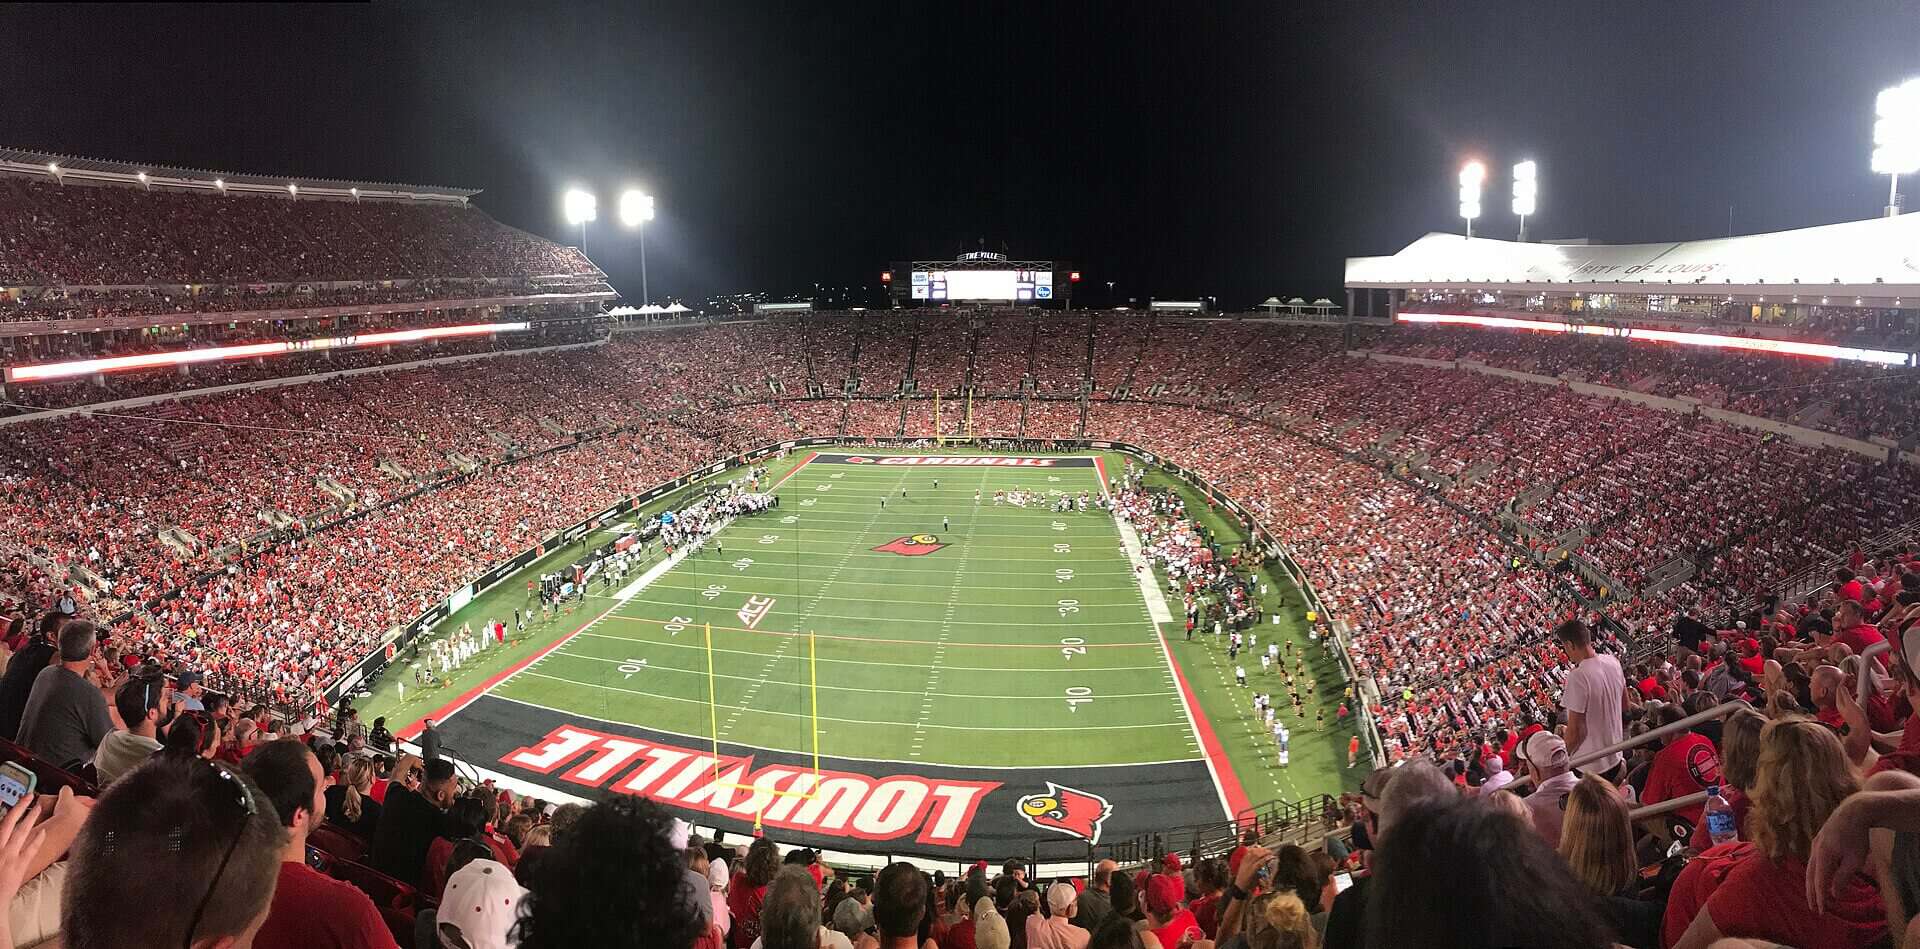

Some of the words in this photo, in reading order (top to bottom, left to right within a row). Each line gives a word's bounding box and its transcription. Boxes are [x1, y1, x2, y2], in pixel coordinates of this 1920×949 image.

[965, 251, 978, 260] THE
[980, 251, 998, 260] VILLE
[877, 456, 1056, 467] CARDINALS
[758, 534, 780, 545] 50
[701, 584, 727, 597] 30
[736, 594, 772, 626] ACC
[1058, 599, 1079, 613] 30
[663, 616, 693, 632] 20
[1060, 637, 1087, 655] 20
[617, 658, 648, 674] 10
[1065, 686, 1094, 705] 10
[500, 724, 1003, 846] LOUISVILLE
